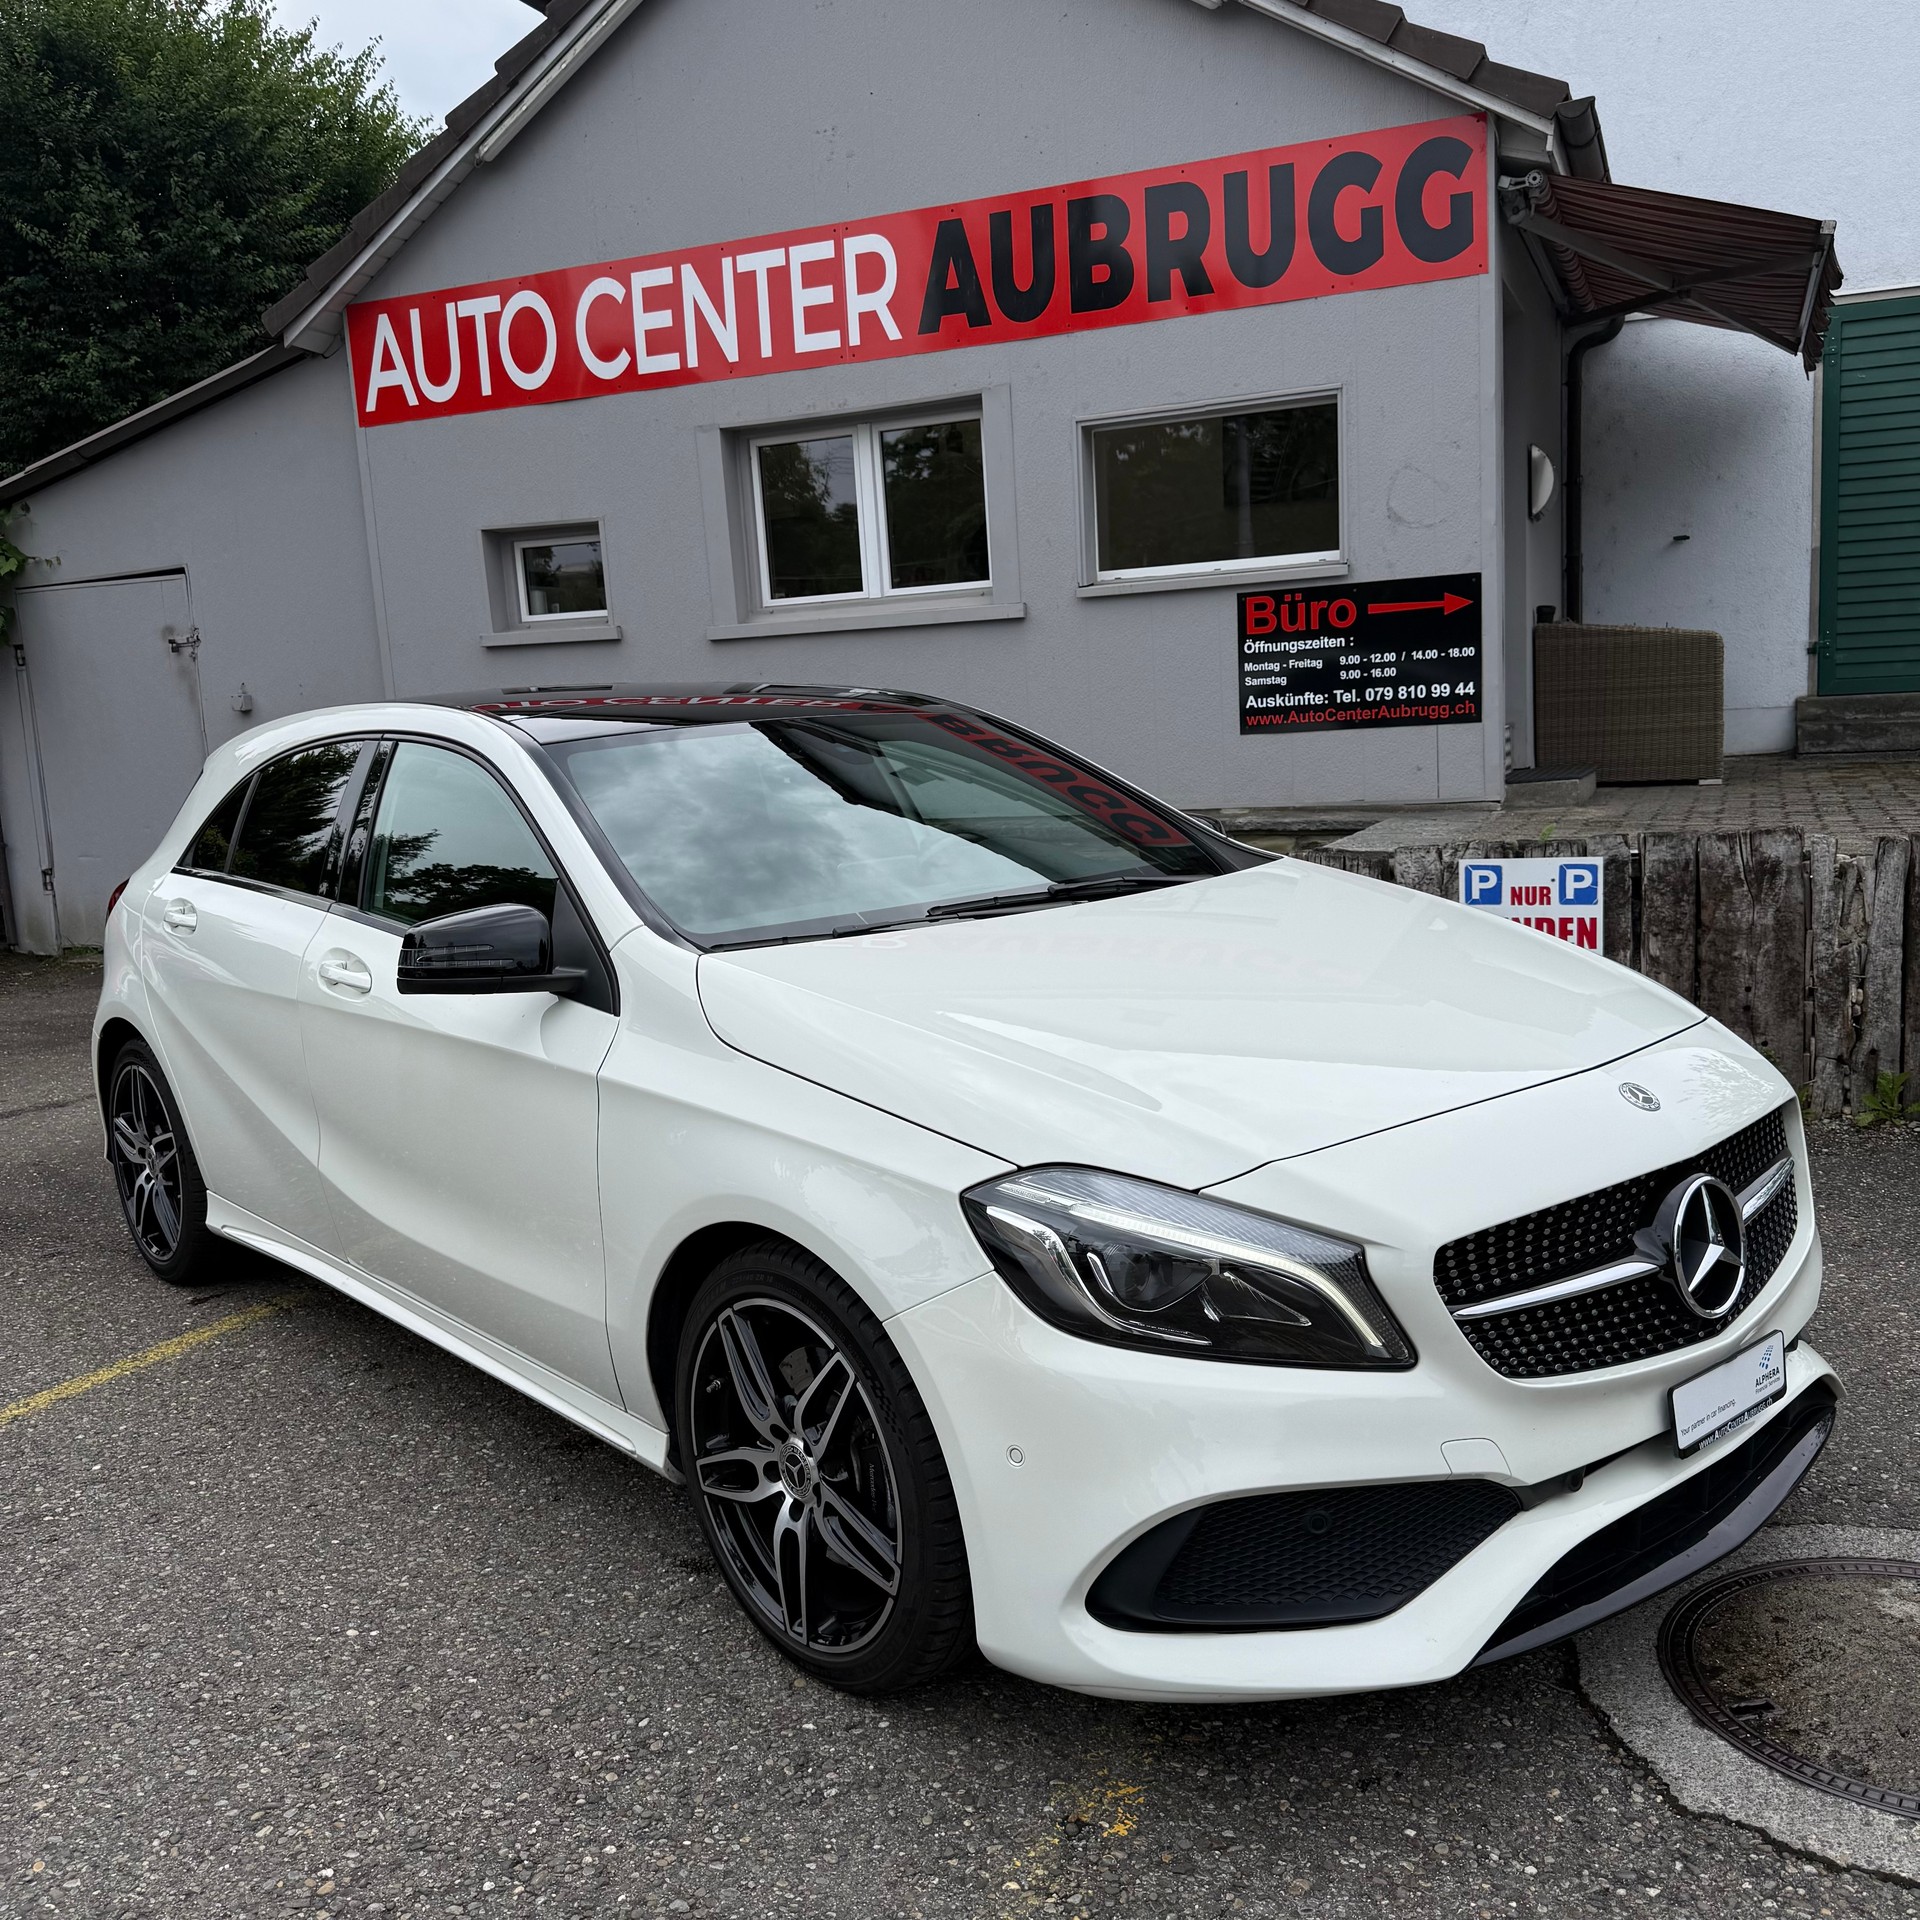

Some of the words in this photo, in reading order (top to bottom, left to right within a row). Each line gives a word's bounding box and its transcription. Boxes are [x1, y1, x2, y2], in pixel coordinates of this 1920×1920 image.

[366, 290, 557, 412] AUTO
[575, 232, 903, 380] CENTER
[918, 136, 1474, 336] AUBRUGG
[1246, 593, 1357, 635] Büro
[1244, 636, 1345, 654] Öffnungszeiten
[1244, 662, 1280, 672] Montag
[1288, 659, 1323, 669] Freitag
[1339, 654, 1360, 665] 9.00
[1369, 652, 1396, 663] 12.00
[1411, 649, 1438, 660] 14.00
[1447, 646, 1475, 658] 18.00
[1244, 676, 1287, 686] Samstag
[1340, 669, 1361, 680] 9.00
[1370, 667, 1396, 678] 16.00
[1245, 691, 1328, 709] Auskünfte:
[1333, 689, 1361, 703] Tel.
[1365, 686, 1393, 701] 079
[1398, 684, 1426, 699] 810
[1431, 683, 1451, 697] 99
[1455, 681, 1475, 696] 44
[1246, 700, 1475, 726] www.AutoCenterAubrugg.ch
[1510, 886, 1552, 906] NUR
[1755, 1366, 1780, 1387] ALPHERA
[1680, 1426, 1691, 1436] Your
[1691, 1416, 1706, 1432] partner
